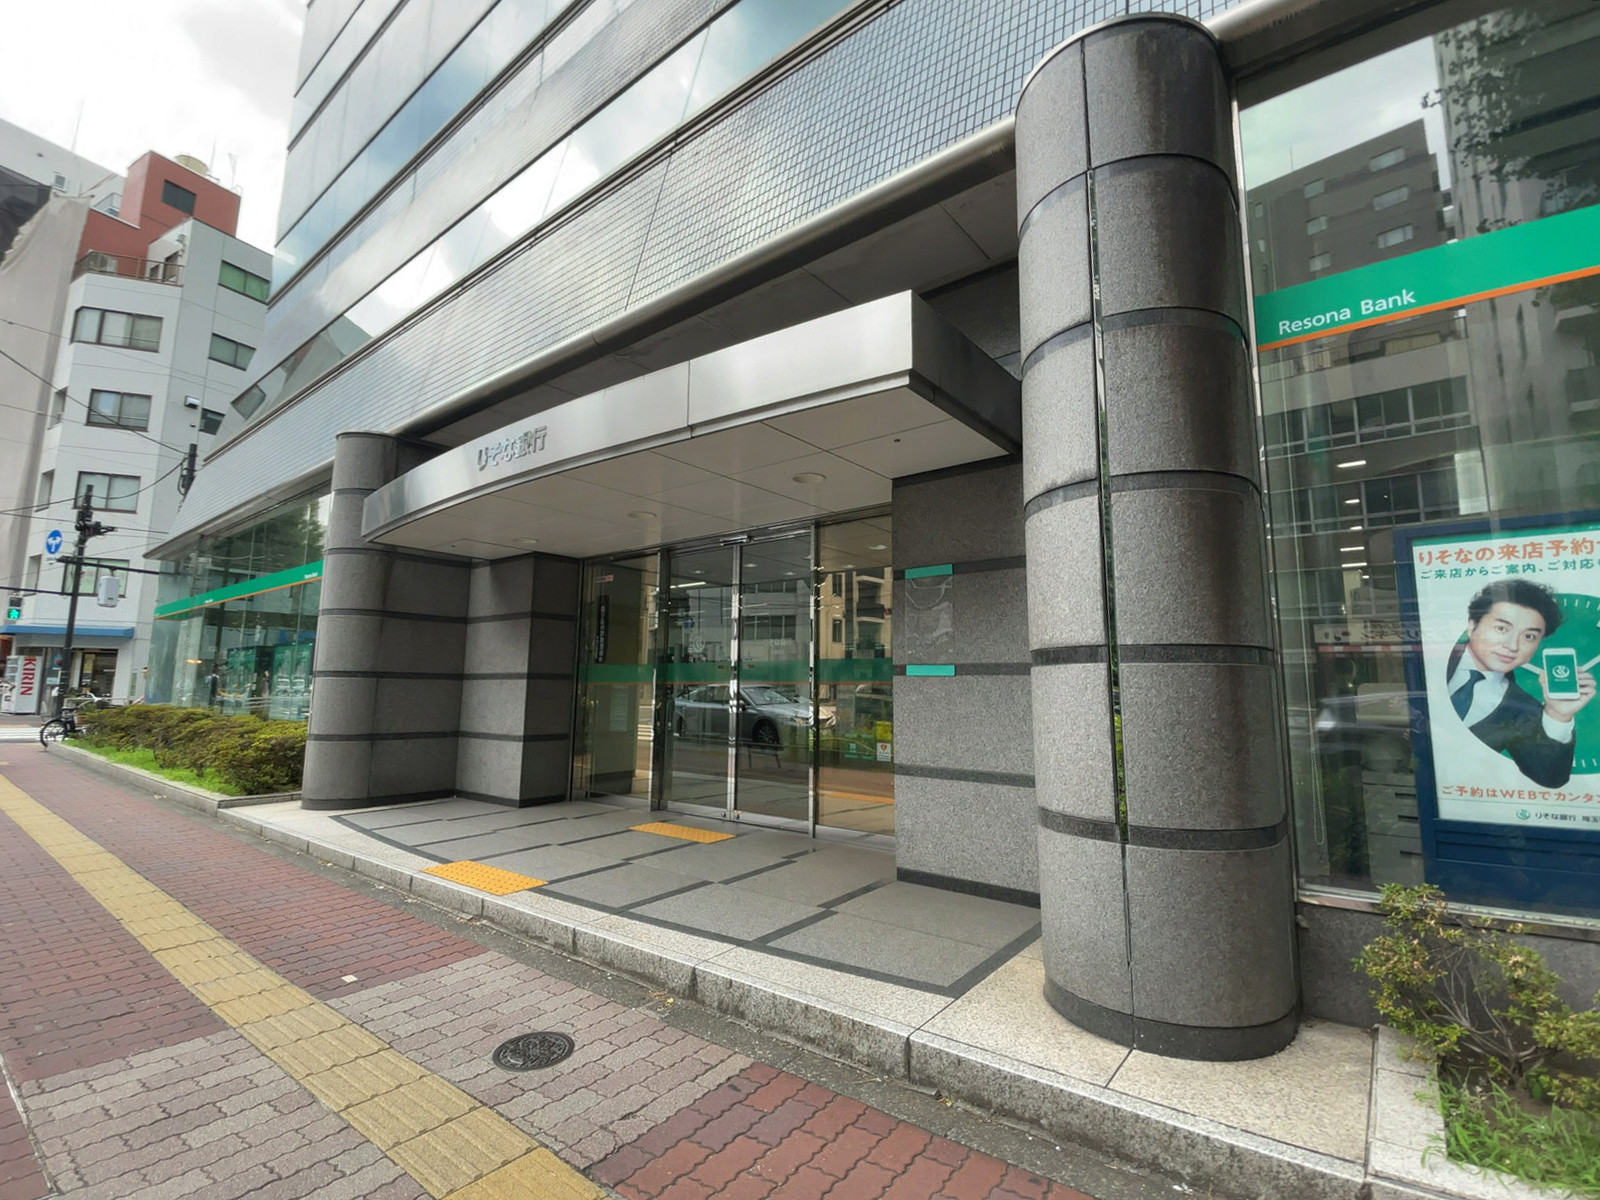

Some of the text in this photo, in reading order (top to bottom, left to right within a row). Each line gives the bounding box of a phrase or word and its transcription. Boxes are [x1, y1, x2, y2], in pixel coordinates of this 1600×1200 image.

[1278, 288, 1416, 335] Resona Bank
[477, 425, 547, 471] りそな銀行
[1418, 536, 1600, 566] りそなの来店予約
[1421, 558, 1600, 580] ご来店からご案内、ご対応
[20, 656, 37, 696] KIRIN
